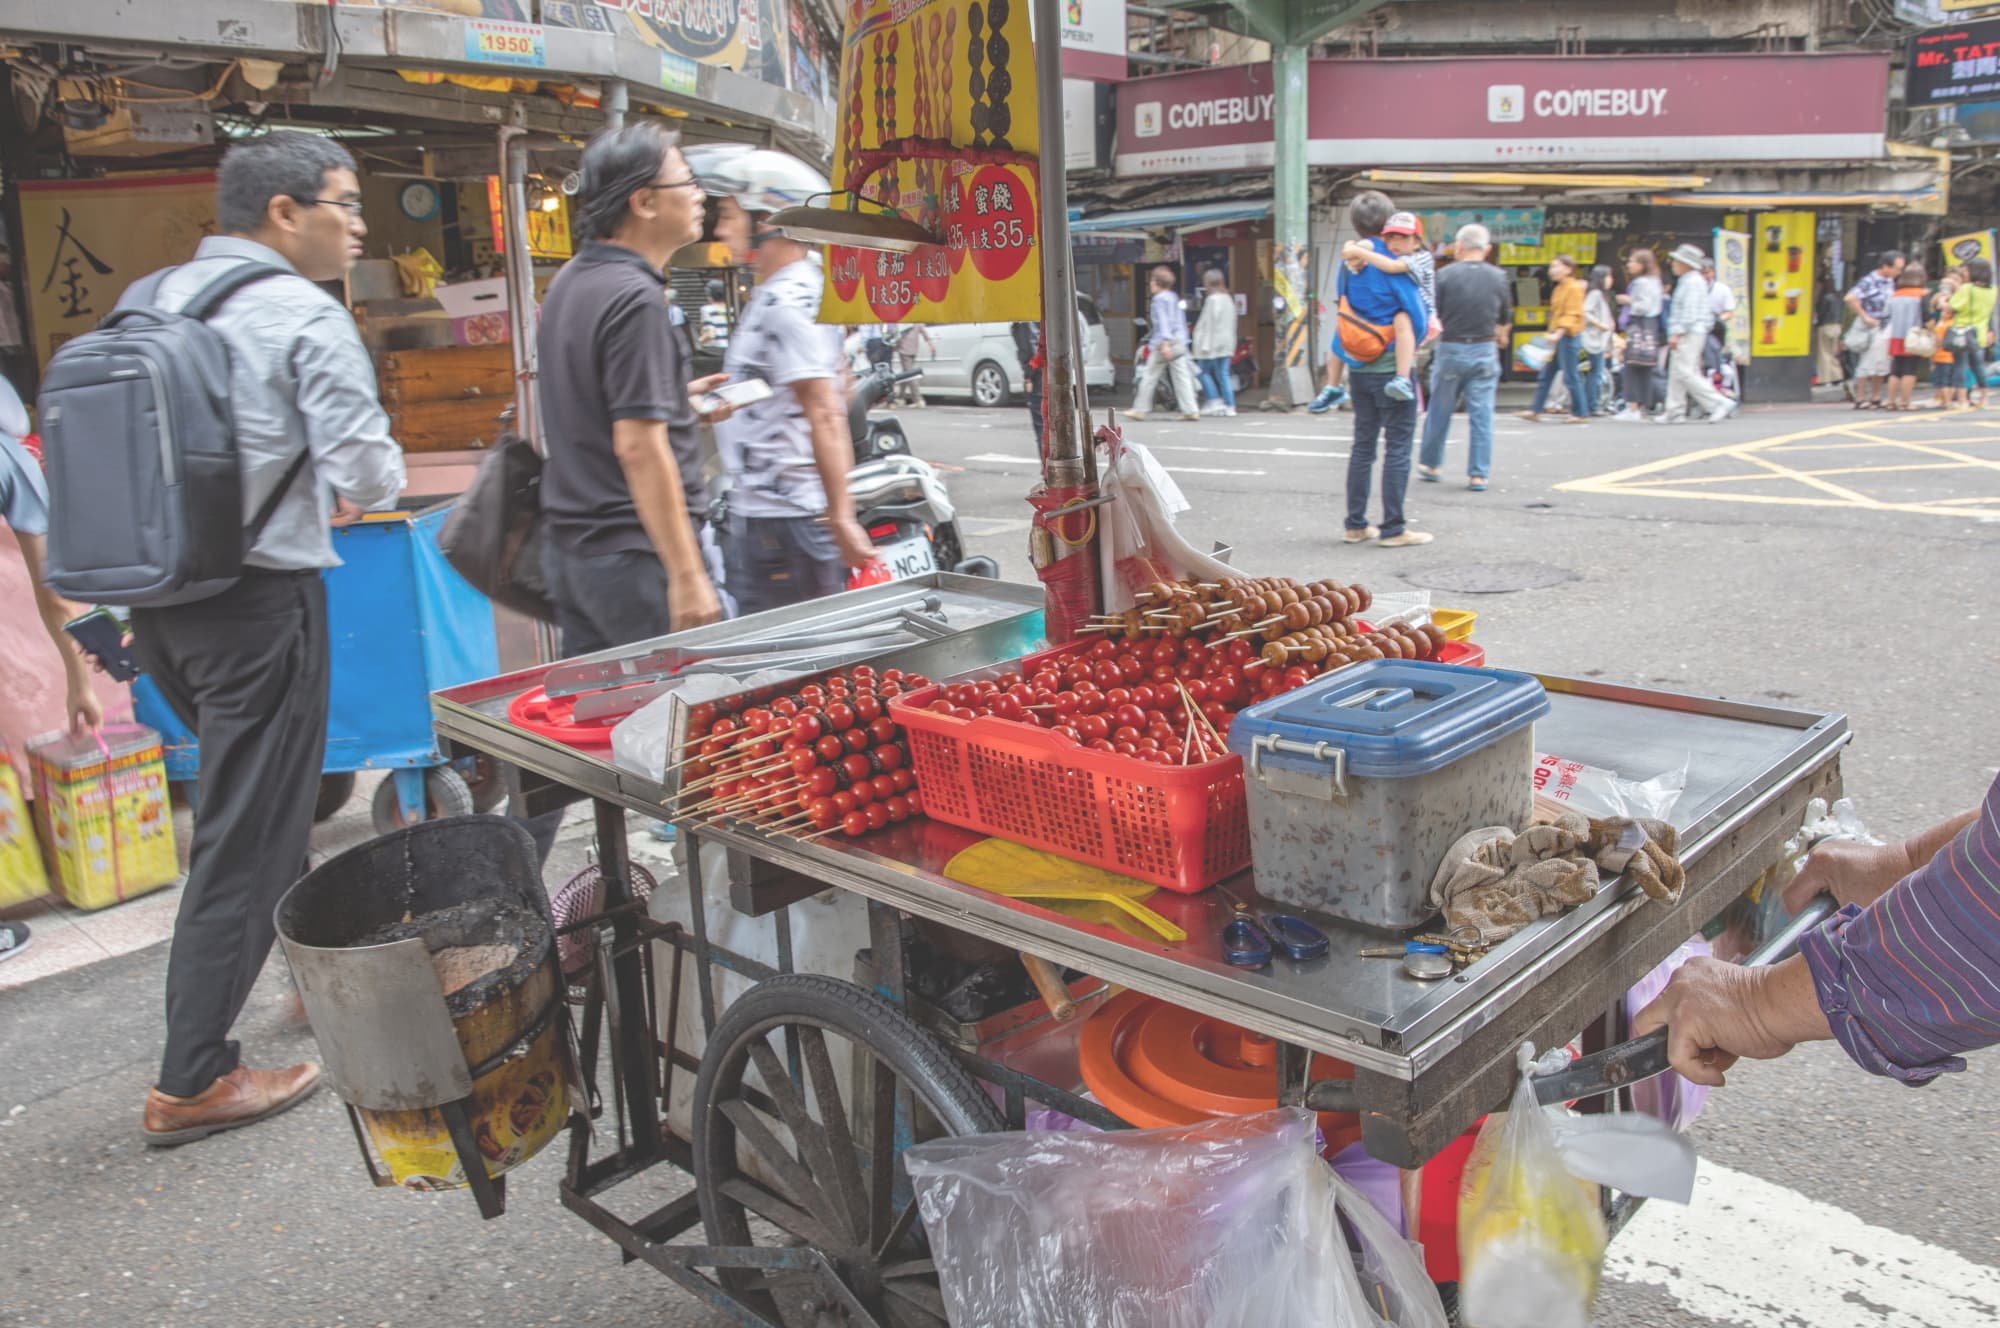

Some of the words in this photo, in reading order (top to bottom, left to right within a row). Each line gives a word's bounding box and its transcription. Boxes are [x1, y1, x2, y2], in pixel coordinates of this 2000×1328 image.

[485, 34, 529, 54] 1950
[1916, 51, 1950, 68] Mr.
[1953, 41, 2000, 61] TAT
[1168, 94, 1275, 129] COMEBUY
[1533, 87, 1667, 117] COMEBUY
[975, 183, 1013, 215] 蜜餞
[41, 206, 114, 318] 金
